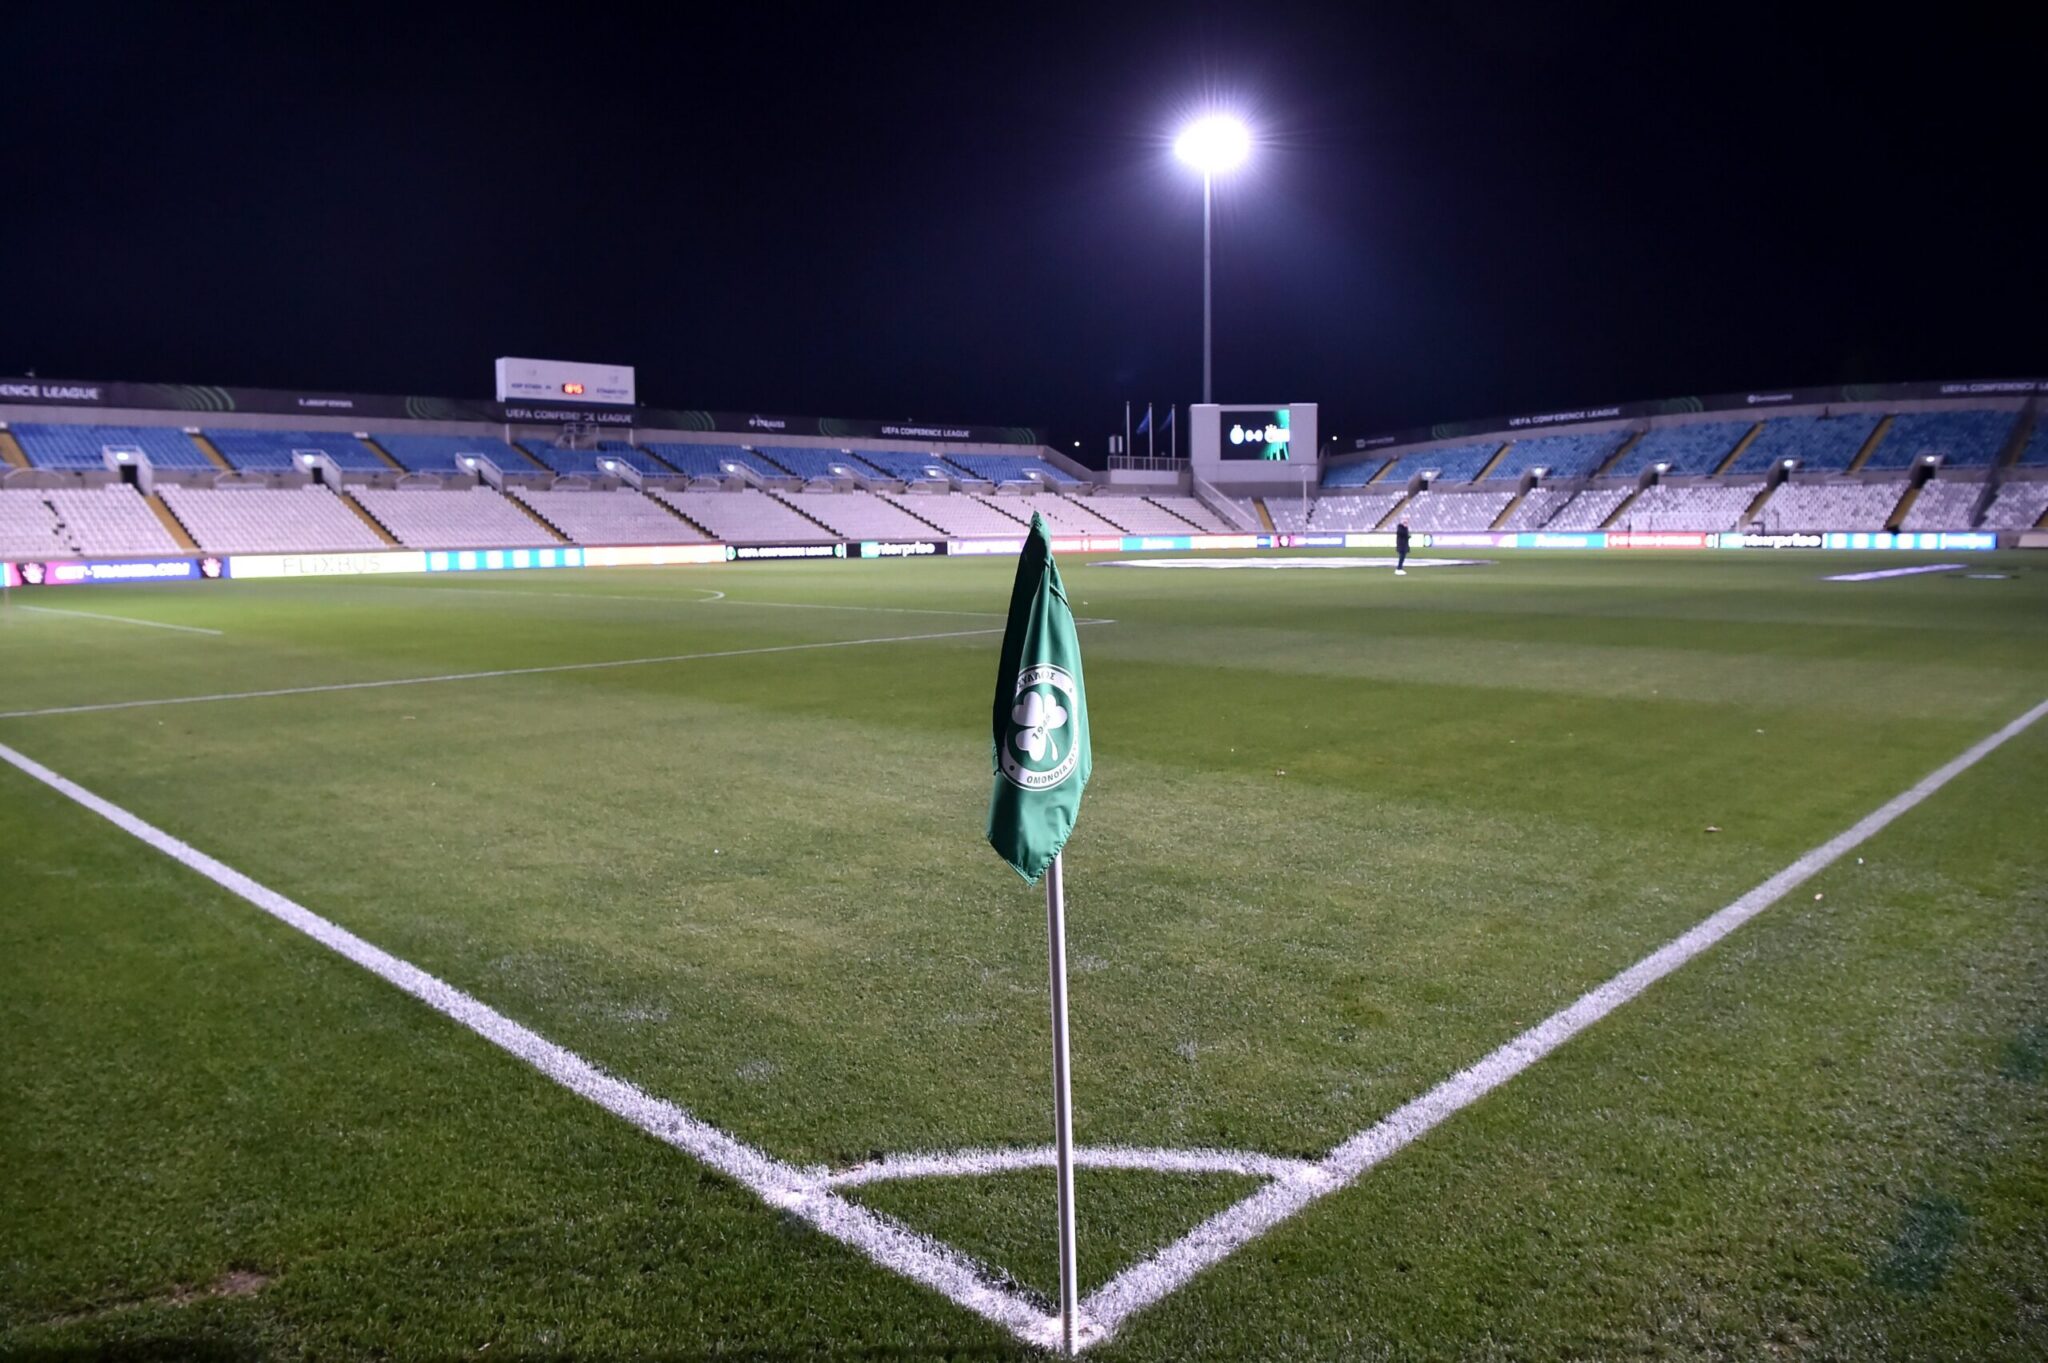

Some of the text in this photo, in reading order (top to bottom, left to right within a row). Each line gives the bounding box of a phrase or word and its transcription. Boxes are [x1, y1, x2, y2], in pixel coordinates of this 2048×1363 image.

[42, 386, 99, 400] LEAGUE
[505, 408, 532, 419] UEFA
[597, 413, 633, 424] LEAGUE
[1509, 416, 1531, 426] UEFA
[1587, 406, 1620, 418] LEAGUE
[881, 426, 970, 439] UEFA CONFERENCE LEAGUE
[864, 541, 935, 557] nterprise
[1724, 533, 1821, 549] nterprise
